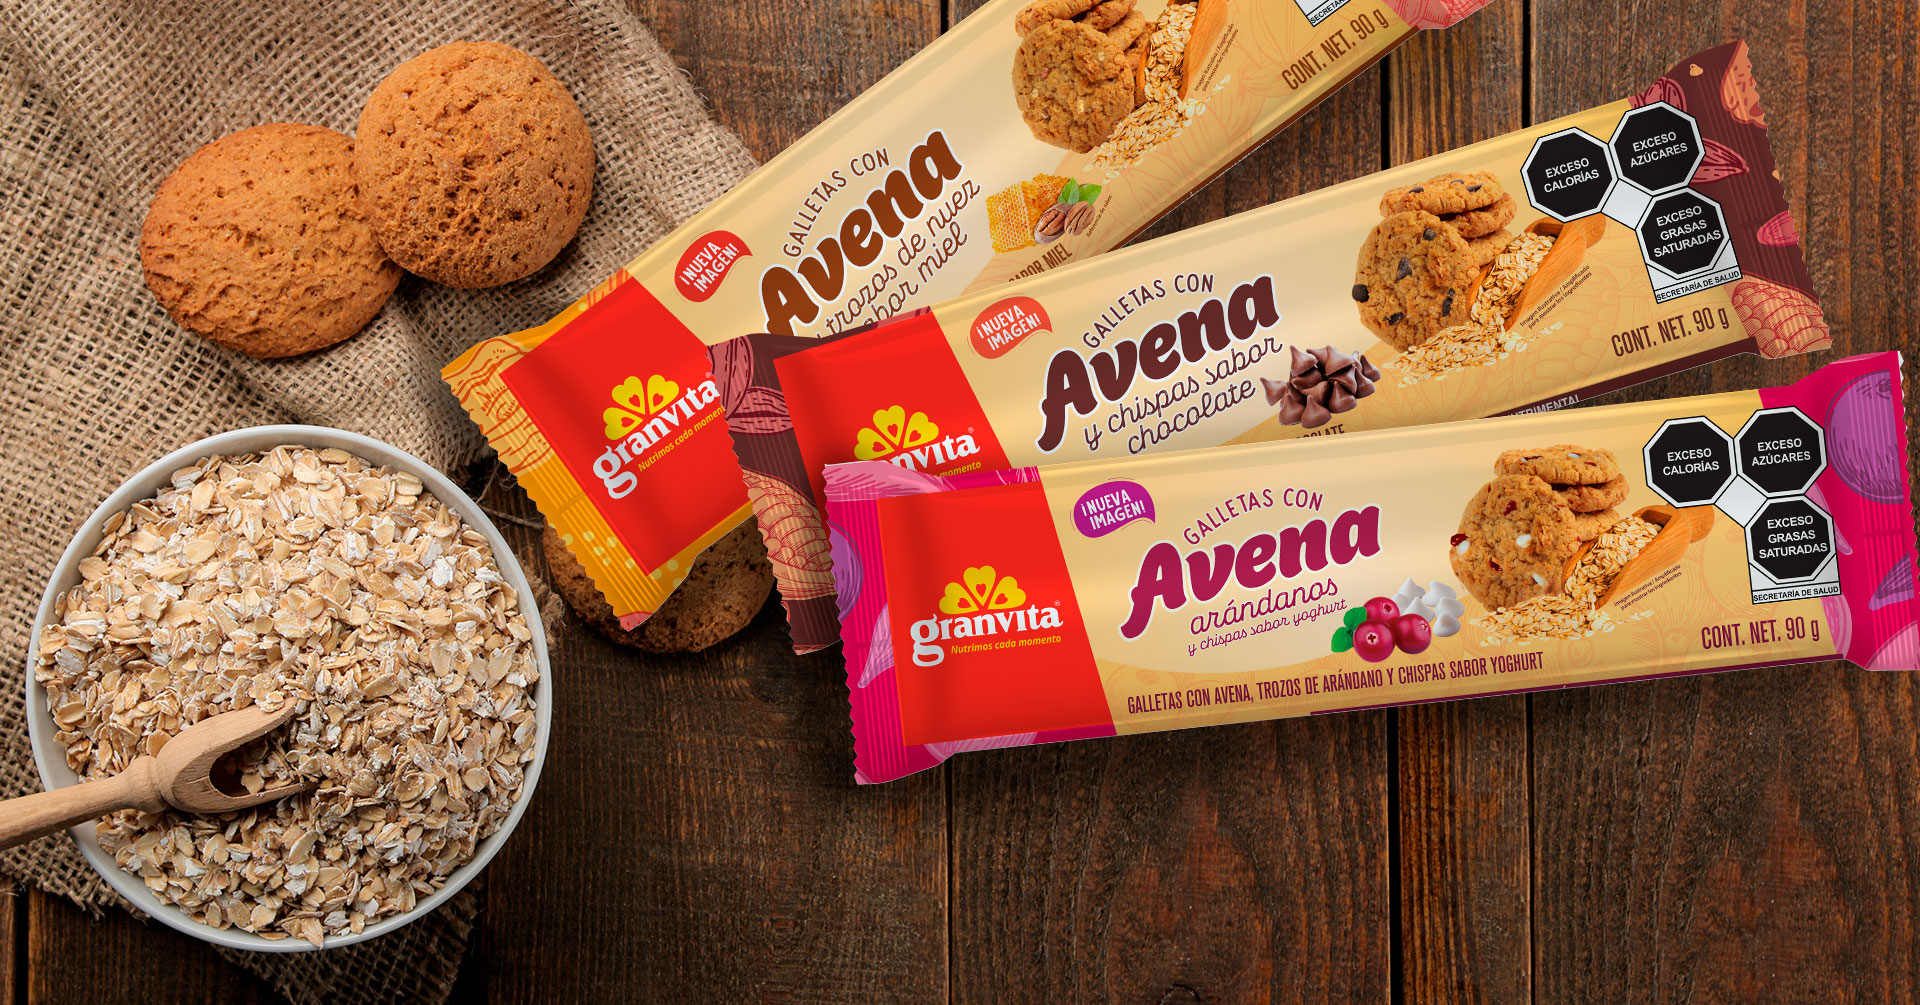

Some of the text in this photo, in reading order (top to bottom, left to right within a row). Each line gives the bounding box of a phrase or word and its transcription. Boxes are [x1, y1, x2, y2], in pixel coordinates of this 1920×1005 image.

[1281, 8, 1389, 90] CONT. NET. 90 g
[1630, 142, 1688, 168] AZÚCARES
[1632, 131, 1676, 152] EXCESO
[1544, 168, 1599, 193] CALORÍAS
[1545, 157, 1589, 178] EXCESO
[783, 148, 889, 257] GALLETAS CON
[1656, 205, 1702, 226] EXCESO
[761, 131, 962, 337] Avena
[898, 233, 926, 266] de
[926, 180, 980, 236] nuez
[1660, 219, 1707, 241] GRASAS
[918, 221, 967, 284] miel
[1041, 243, 1073, 270] MIEL
[1654, 229, 1721, 257] SATURADAS
[679, 242, 721, 285] ¡NUEVA
[693, 243, 739, 293] IMAGEN!
[1656, 270, 1740, 301] SECRETARÍA DE SALUD
[976, 305, 1025, 339] ¡NUEVA
[1082, 274, 1214, 348] GALLETAS CON
[987, 313, 1042, 351] IMAGEN!
[1611, 307, 1730, 357] CONT. NET. 90 g
[1037, 276, 1280, 452] Avena
[1084, 337, 1283, 451] y chispas sabor
[1128, 379, 1256, 455] chocolate
[593, 380, 720, 499] granvita
[638, 405, 726, 472] Nutrimos cada moment
[1667, 447, 1712, 462] EXCESO
[1757, 438, 1802, 452] EXCESO
[1662, 460, 1720, 476] CALORÍAS
[1751, 450, 1811, 466] AZÚCARES
[1081, 489, 1131, 517] ¡NUEVA
[1089, 500, 1146, 530] IMAGEN!
[1183, 488, 1323, 544] GALLETAS CON
[1767, 515, 1814, 529] EXCESO
[1768, 529, 1816, 544] GRASAS
[1759, 542, 1828, 559] SATURADAS
[1120, 506, 1381, 639] Avena
[1190, 578, 1338, 634] arándanos
[1753, 585, 1839, 602] SECRETARÍA DE SALUD
[910, 604, 1064, 667] granvita
[1188, 598, 1347, 656] y chispas sabor yoghurt
[1701, 616, 1820, 649] CONT. NET. 90 g
[951, 635, 1062, 654] Nutrimos cada momento
[1127, 651, 1543, 714] GALLETAS CON AVENA, TROZOS DE ARÁNDANO Y CHISPAS SABOR YOGHURT
